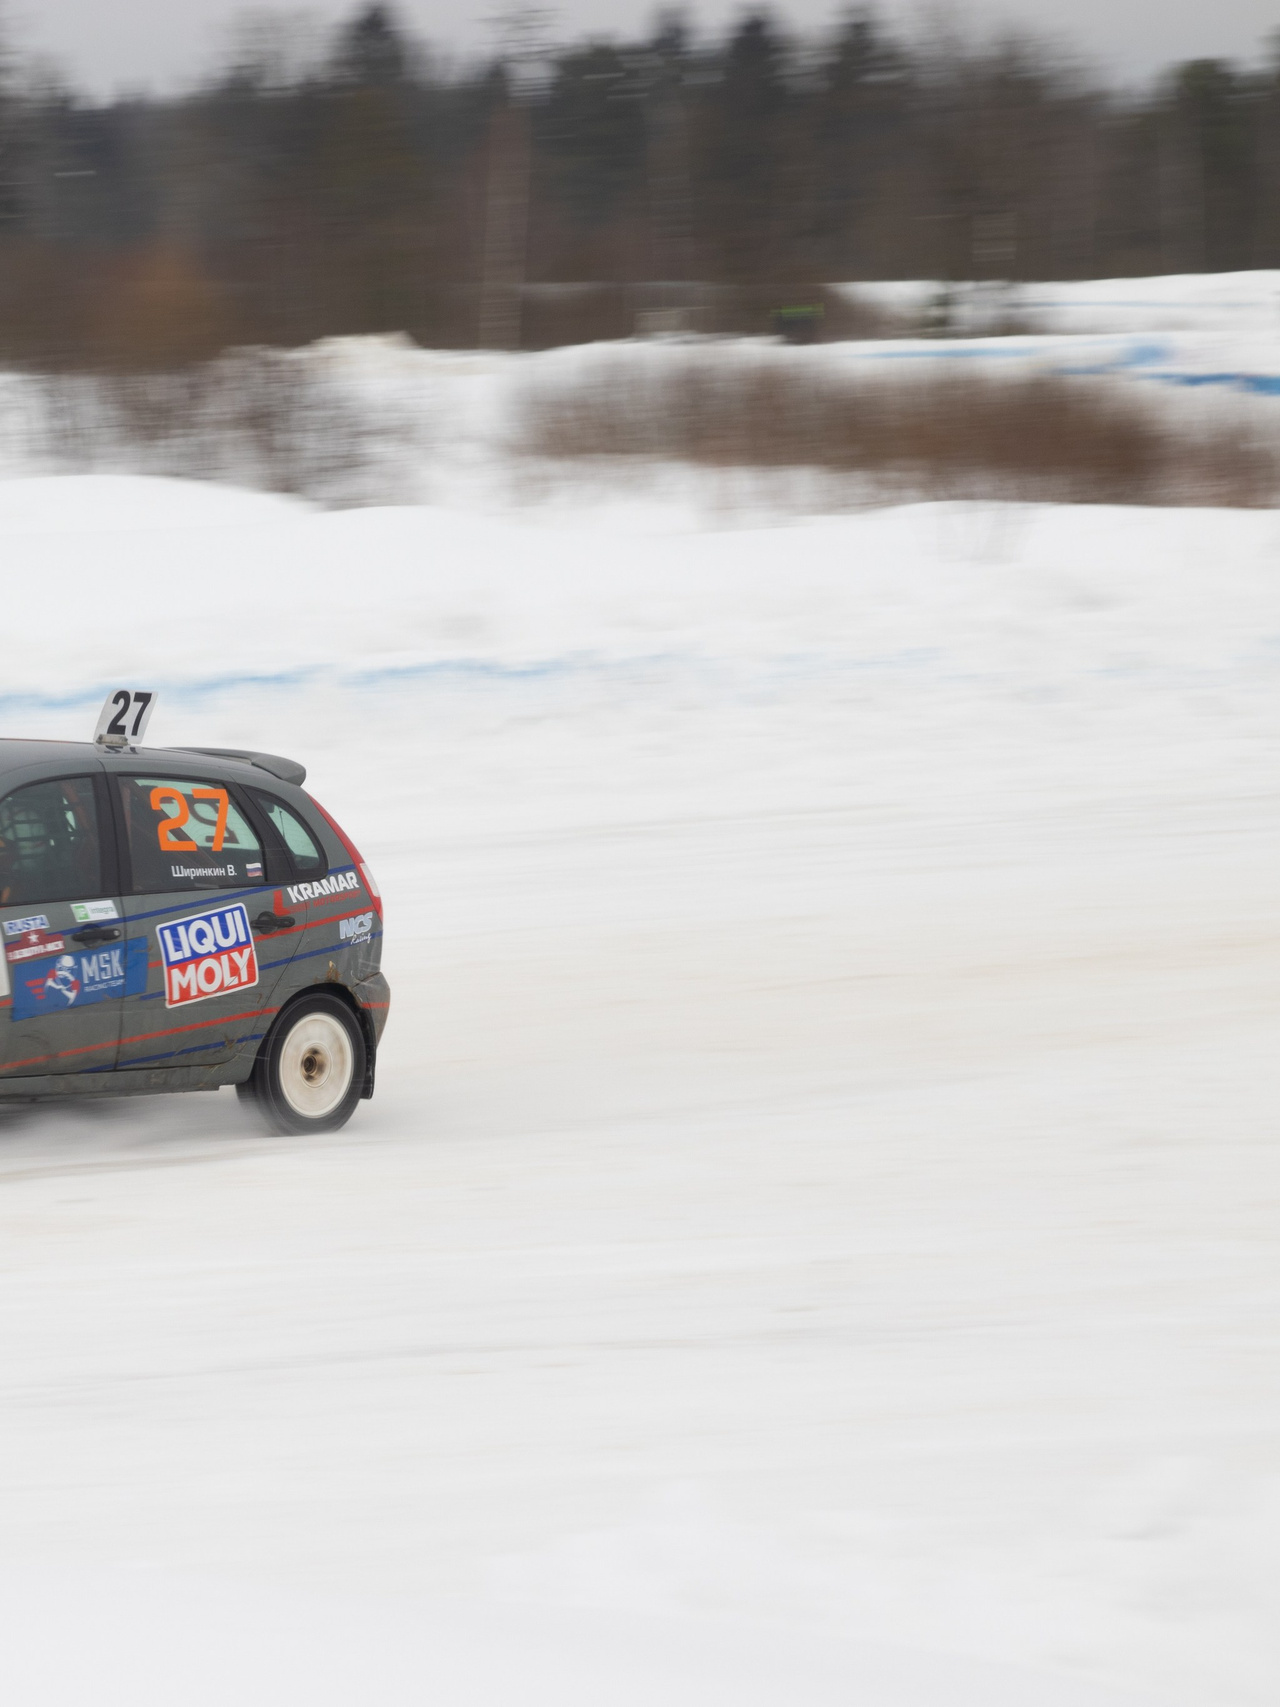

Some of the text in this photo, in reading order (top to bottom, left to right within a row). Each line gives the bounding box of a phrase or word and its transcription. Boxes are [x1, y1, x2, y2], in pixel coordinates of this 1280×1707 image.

[107, 690, 152, 736] 27
[150, 787, 229, 851] 27
[171, 865, 226, 880] Ширинкин
[287, 872, 360, 903] KRAMAR
[163, 909, 247, 962] LIQUI
[81, 949, 125, 984] MSK
[170, 947, 252, 1001] MOLY
